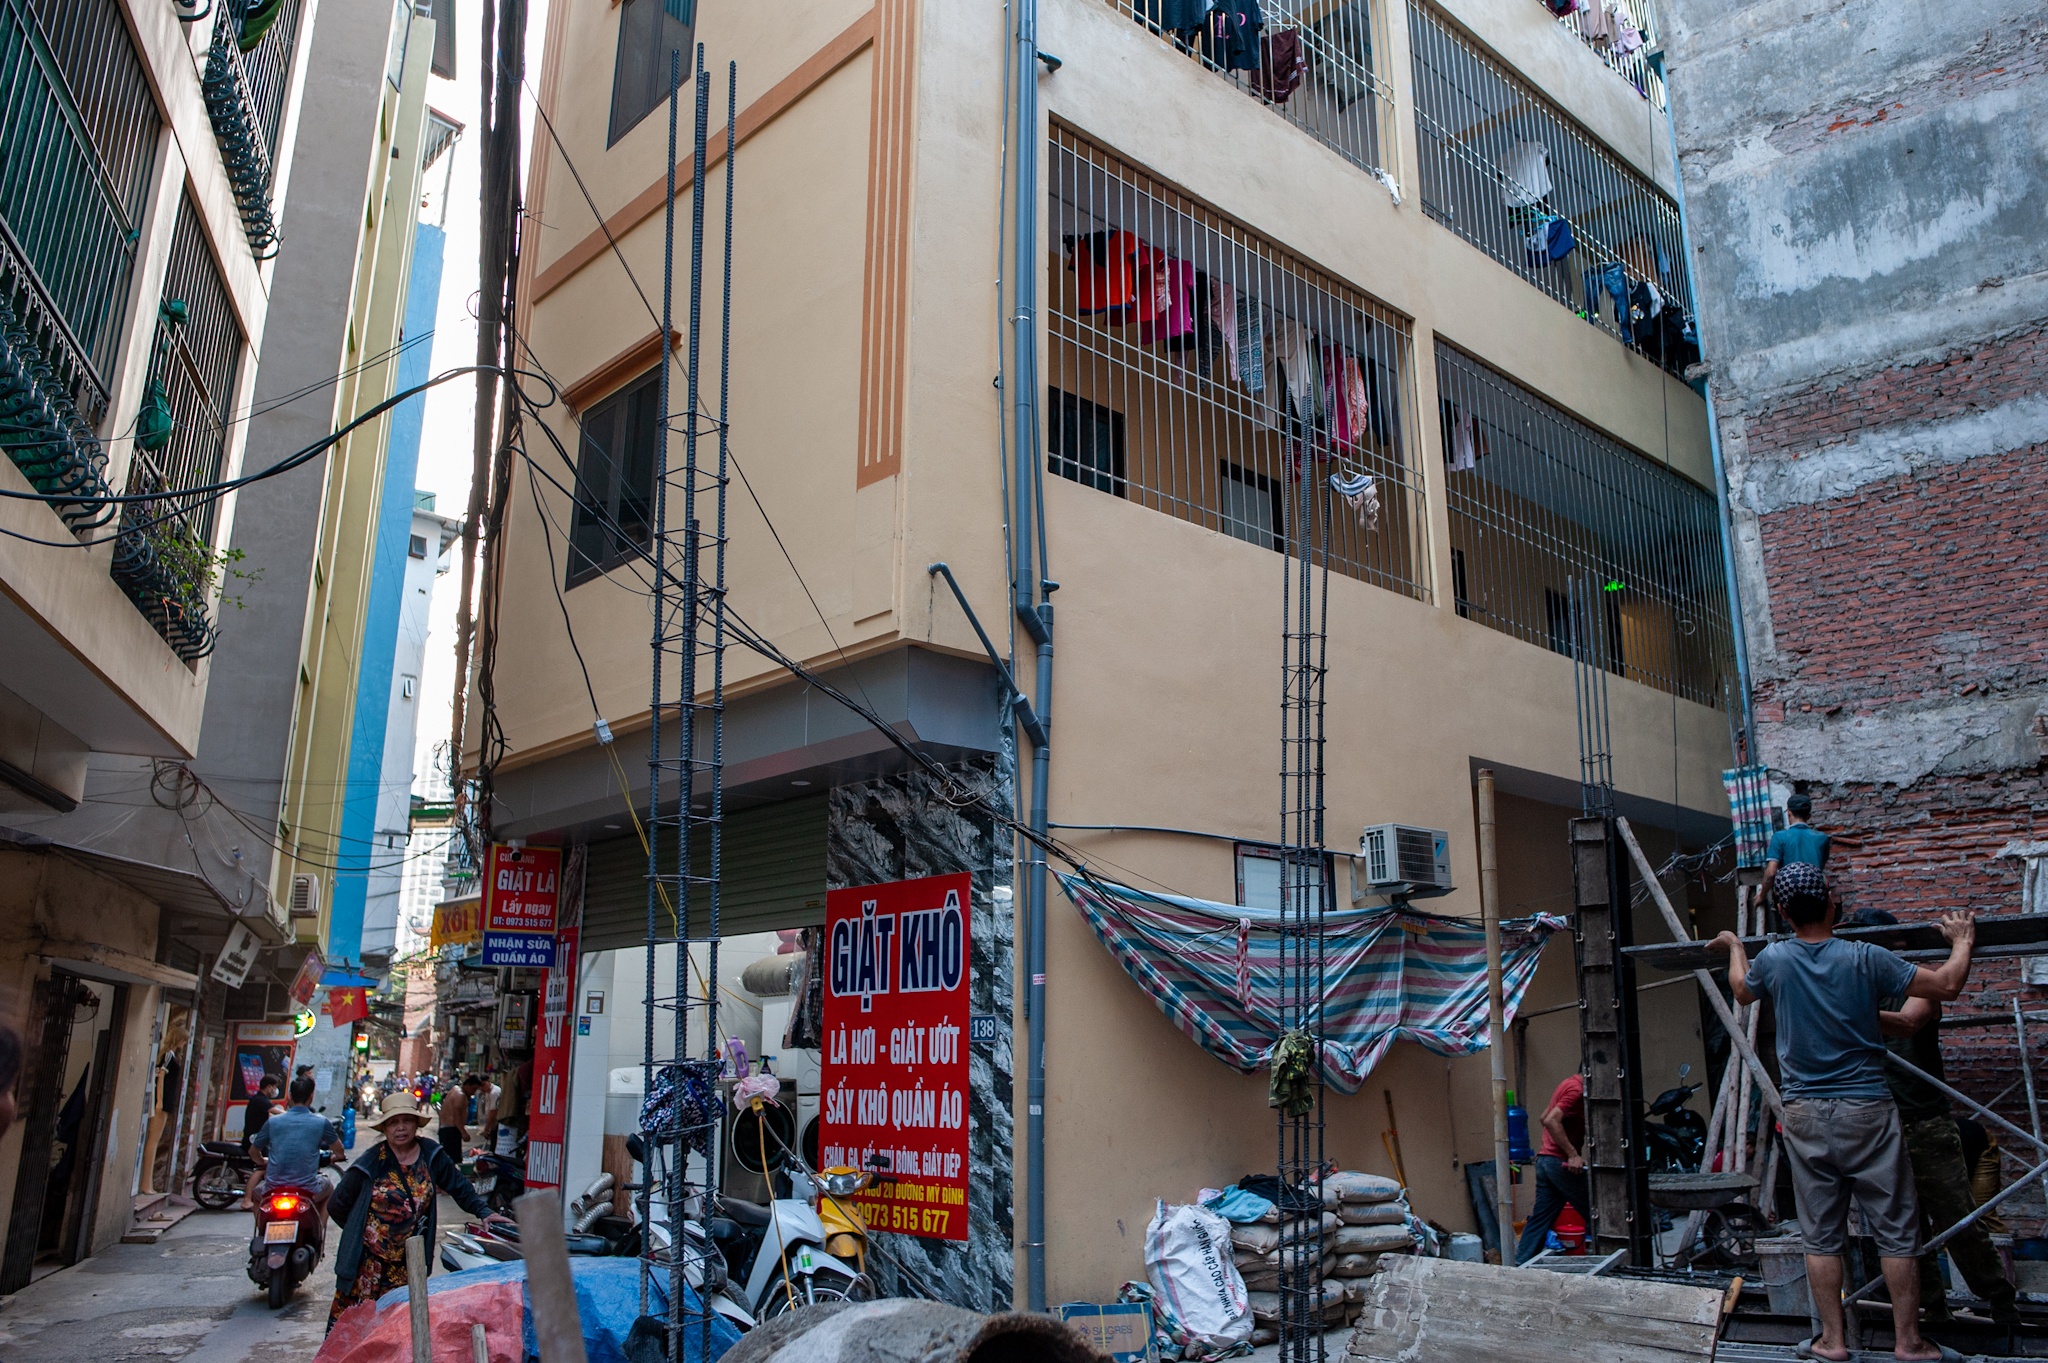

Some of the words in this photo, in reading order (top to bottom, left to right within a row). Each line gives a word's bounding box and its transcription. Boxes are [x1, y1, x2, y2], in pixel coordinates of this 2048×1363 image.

[497, 866, 533, 896] GIẶT
[536, 869, 555, 893] LÀ
[441, 905, 469, 934] XÔI
[502, 898, 522, 915] Lấy
[525, 903, 551, 916] ngay
[493, 916, 504, 925] ĐT:
[506, 917, 523, 926] 0973
[525, 918, 538, 926] 515
[539, 919, 552, 927] 677
[489, 937, 523, 950] NHẬN
[527, 936, 551, 950] SỬA
[830, 899, 895, 1013] GIẶT
[899, 889, 963, 993] KHÔ
[492, 950, 526, 964] QUẦN
[529, 951, 546, 964] ÁO
[974, 1020, 994, 1038] 138
[830, 1022, 847, 1064] LÀ
[851, 1026, 876, 1065] HƠI
[880, 1045, 886, 1053] -
[890, 1020, 925, 1072] GIẶT
[929, 1015, 960, 1064] ƯỚT
[540, 1060, 559, 1115] LẤY
[826, 1076, 854, 1124] SẤY
[858, 1081, 888, 1126] KHÔ
[892, 1076, 936, 1131] QUẦN
[939, 1082, 962, 1130] ÁO
[527, 1140, 561, 1184] NHANH
[896, 1145, 920, 1178] BÔNG,
[944, 1148, 961, 1178] DÉP
[884, 1182, 894, 1198] 20
[895, 1180, 924, 1202] ĐƯỜNG
[926, 1183, 940, 1203] MỸ
[942, 1184, 964, 1205] ĐÌNH
[857, 1202, 888, 1227] 0973
[892, 1206, 918, 1230] 515
[922, 1208, 950, 1234] 677
[1198, 1240, 1212, 1256] HÀN
[1203, 1256, 1218, 1270] CẤP
[1212, 1270, 1224, 1287] CAO
[1218, 1288, 1232, 1308] NHỰA
